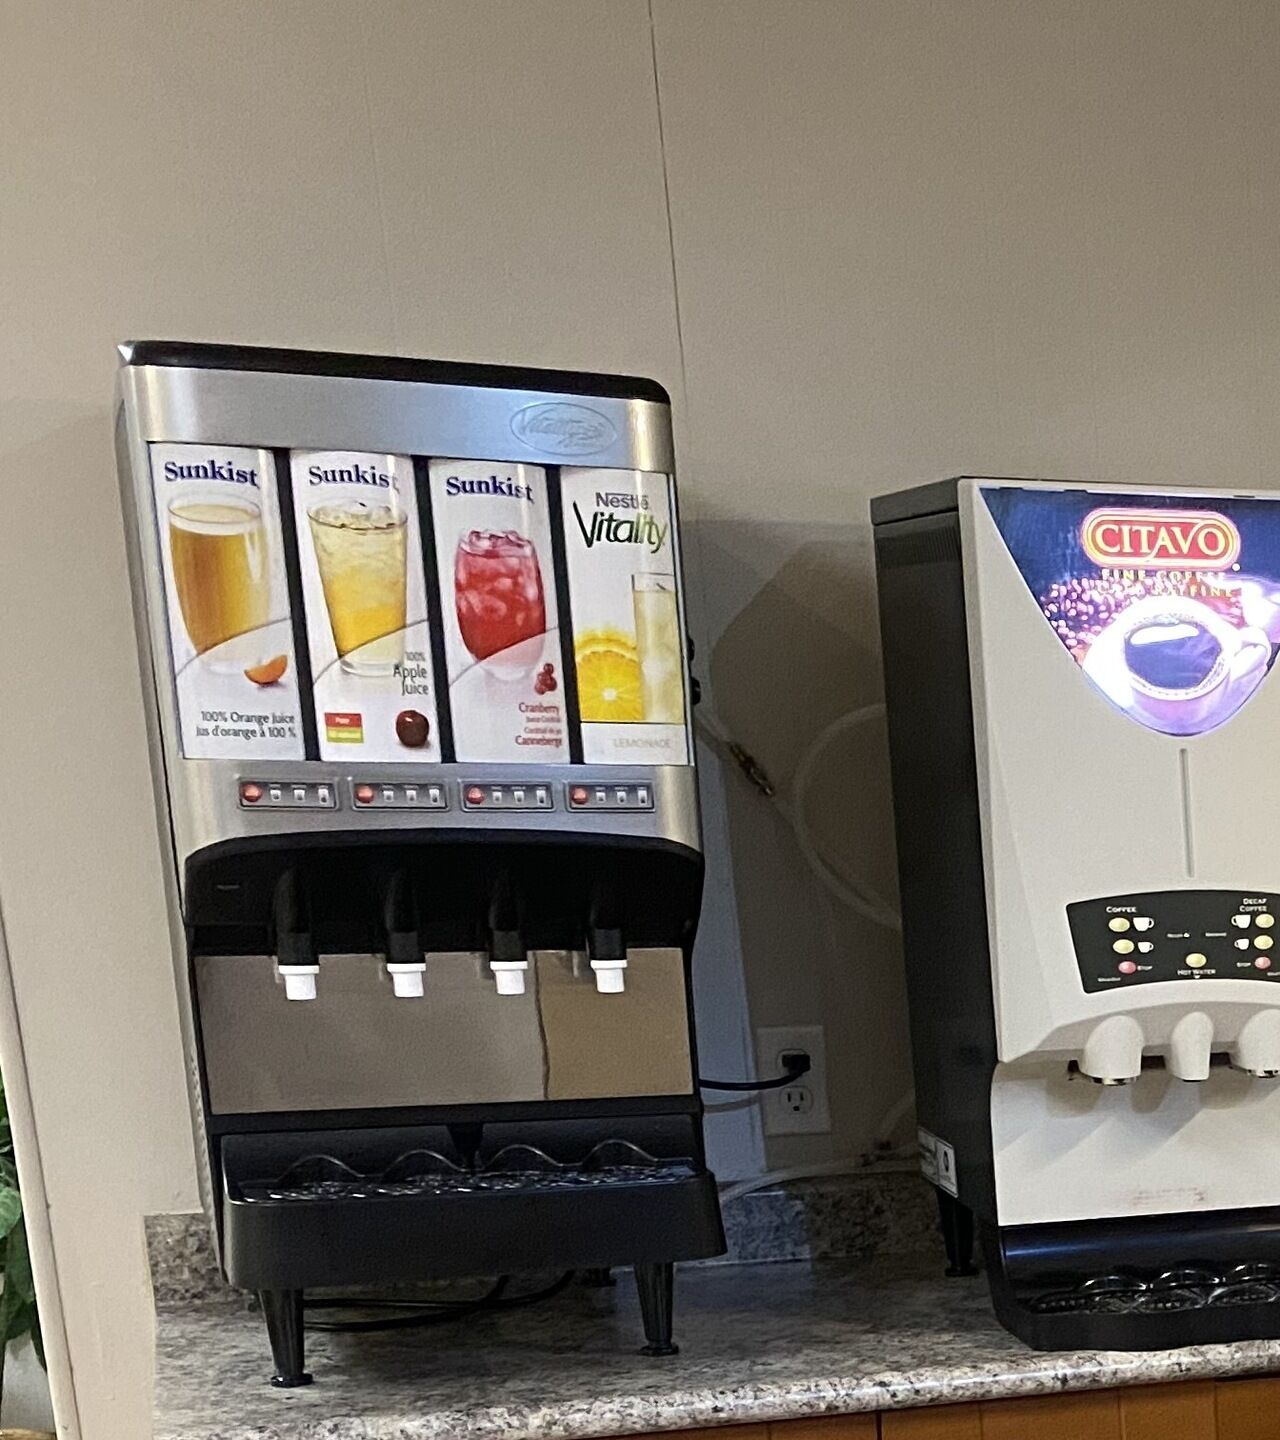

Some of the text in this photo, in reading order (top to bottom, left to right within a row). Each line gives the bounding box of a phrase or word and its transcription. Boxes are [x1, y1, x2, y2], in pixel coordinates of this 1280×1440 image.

[164, 459, 260, 489] Sunkist
[309, 463, 400, 494] Sunkist
[446, 475, 535, 504] Sunkist
[573, 501, 668, 554] Vitality
[1095, 523, 1226, 558] CITAVO
[393, 664, 428, 684] Apple
[402, 680, 429, 696] Juice
[201, 710, 228, 722] 100%
[230, 711, 270, 726] Orange
[518, 702, 560, 716] Cranberry
[211, 725, 257, 741] d'orange
[268, 727, 286, 738] 100
